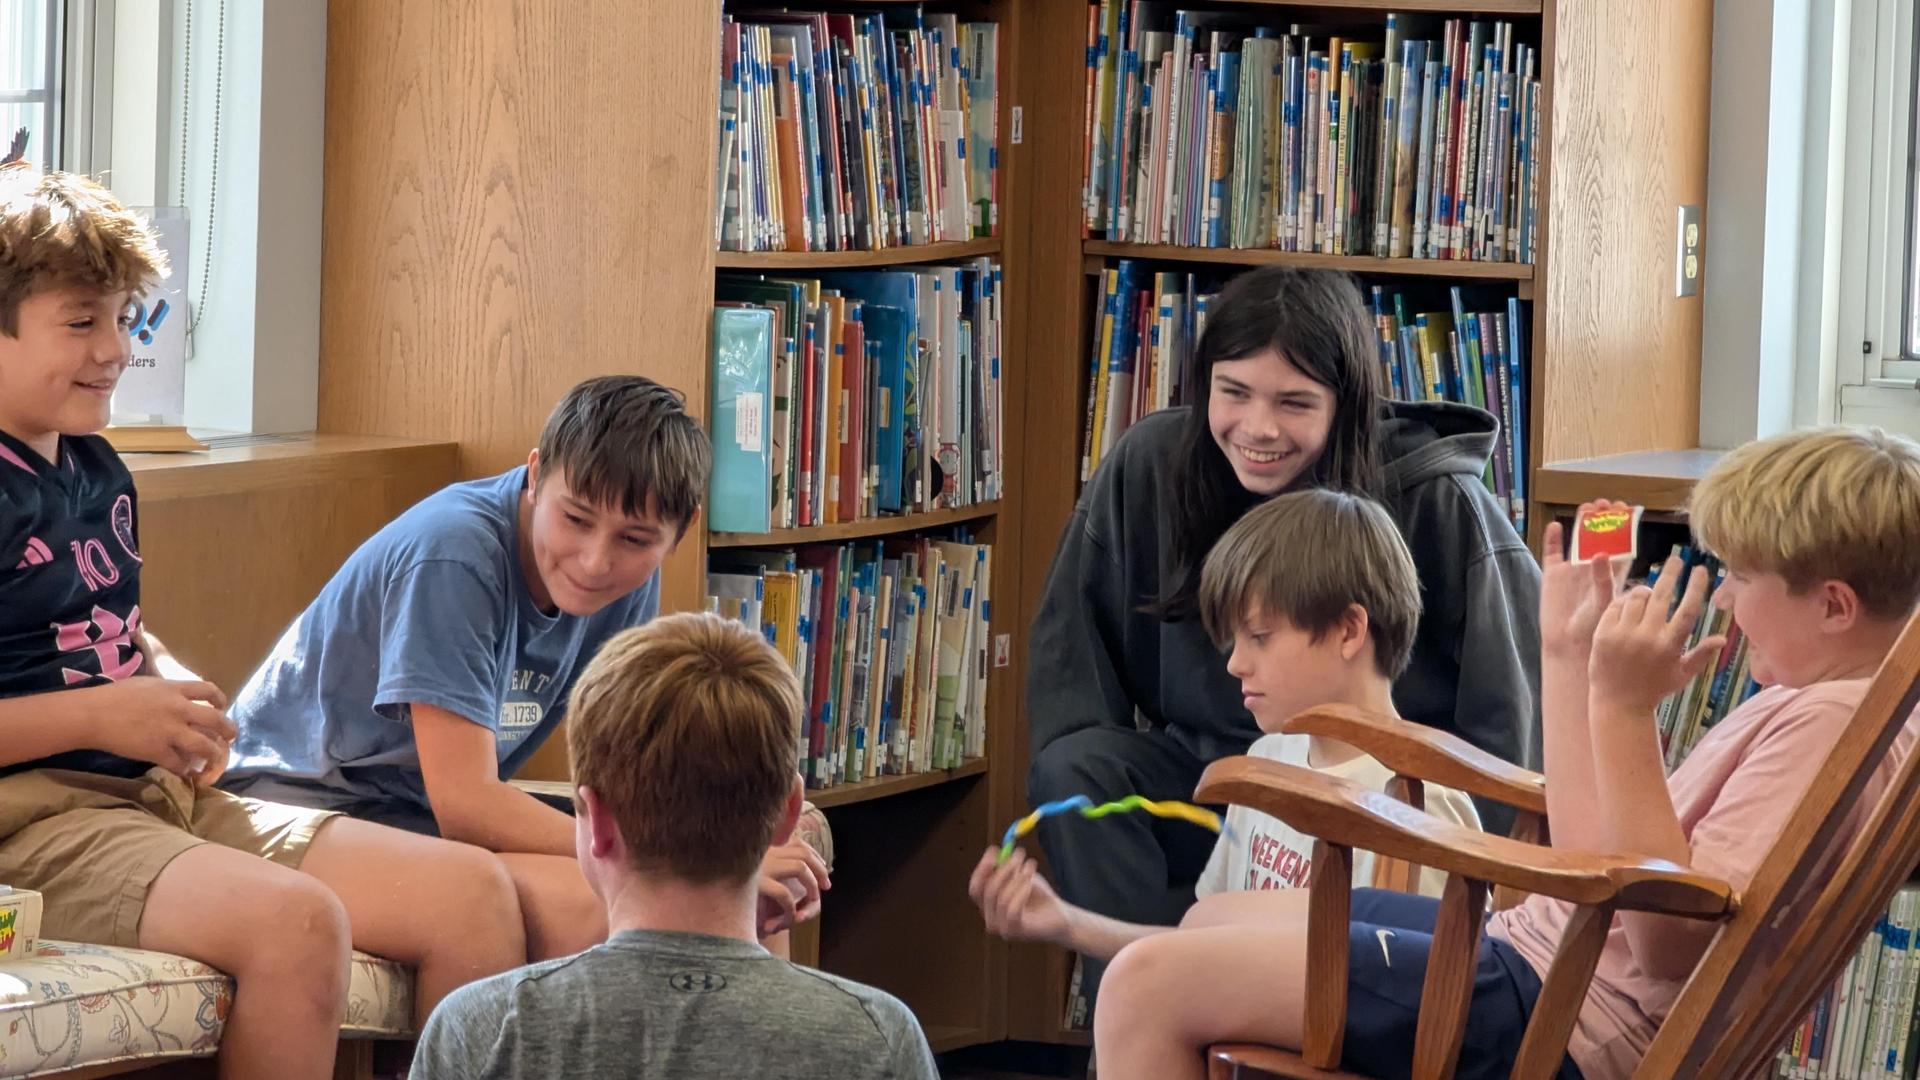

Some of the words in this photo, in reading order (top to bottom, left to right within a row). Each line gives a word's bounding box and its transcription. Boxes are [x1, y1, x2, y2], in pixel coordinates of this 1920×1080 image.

[127, 354, 156, 368] ders
[1499, 366, 1507, 402] Kitten's
[71, 538, 119, 592] 10
[507, 669, 550, 693] ENT
[514, 705, 537, 723] 1739
[1251, 833, 1311, 888] WEEKEN
